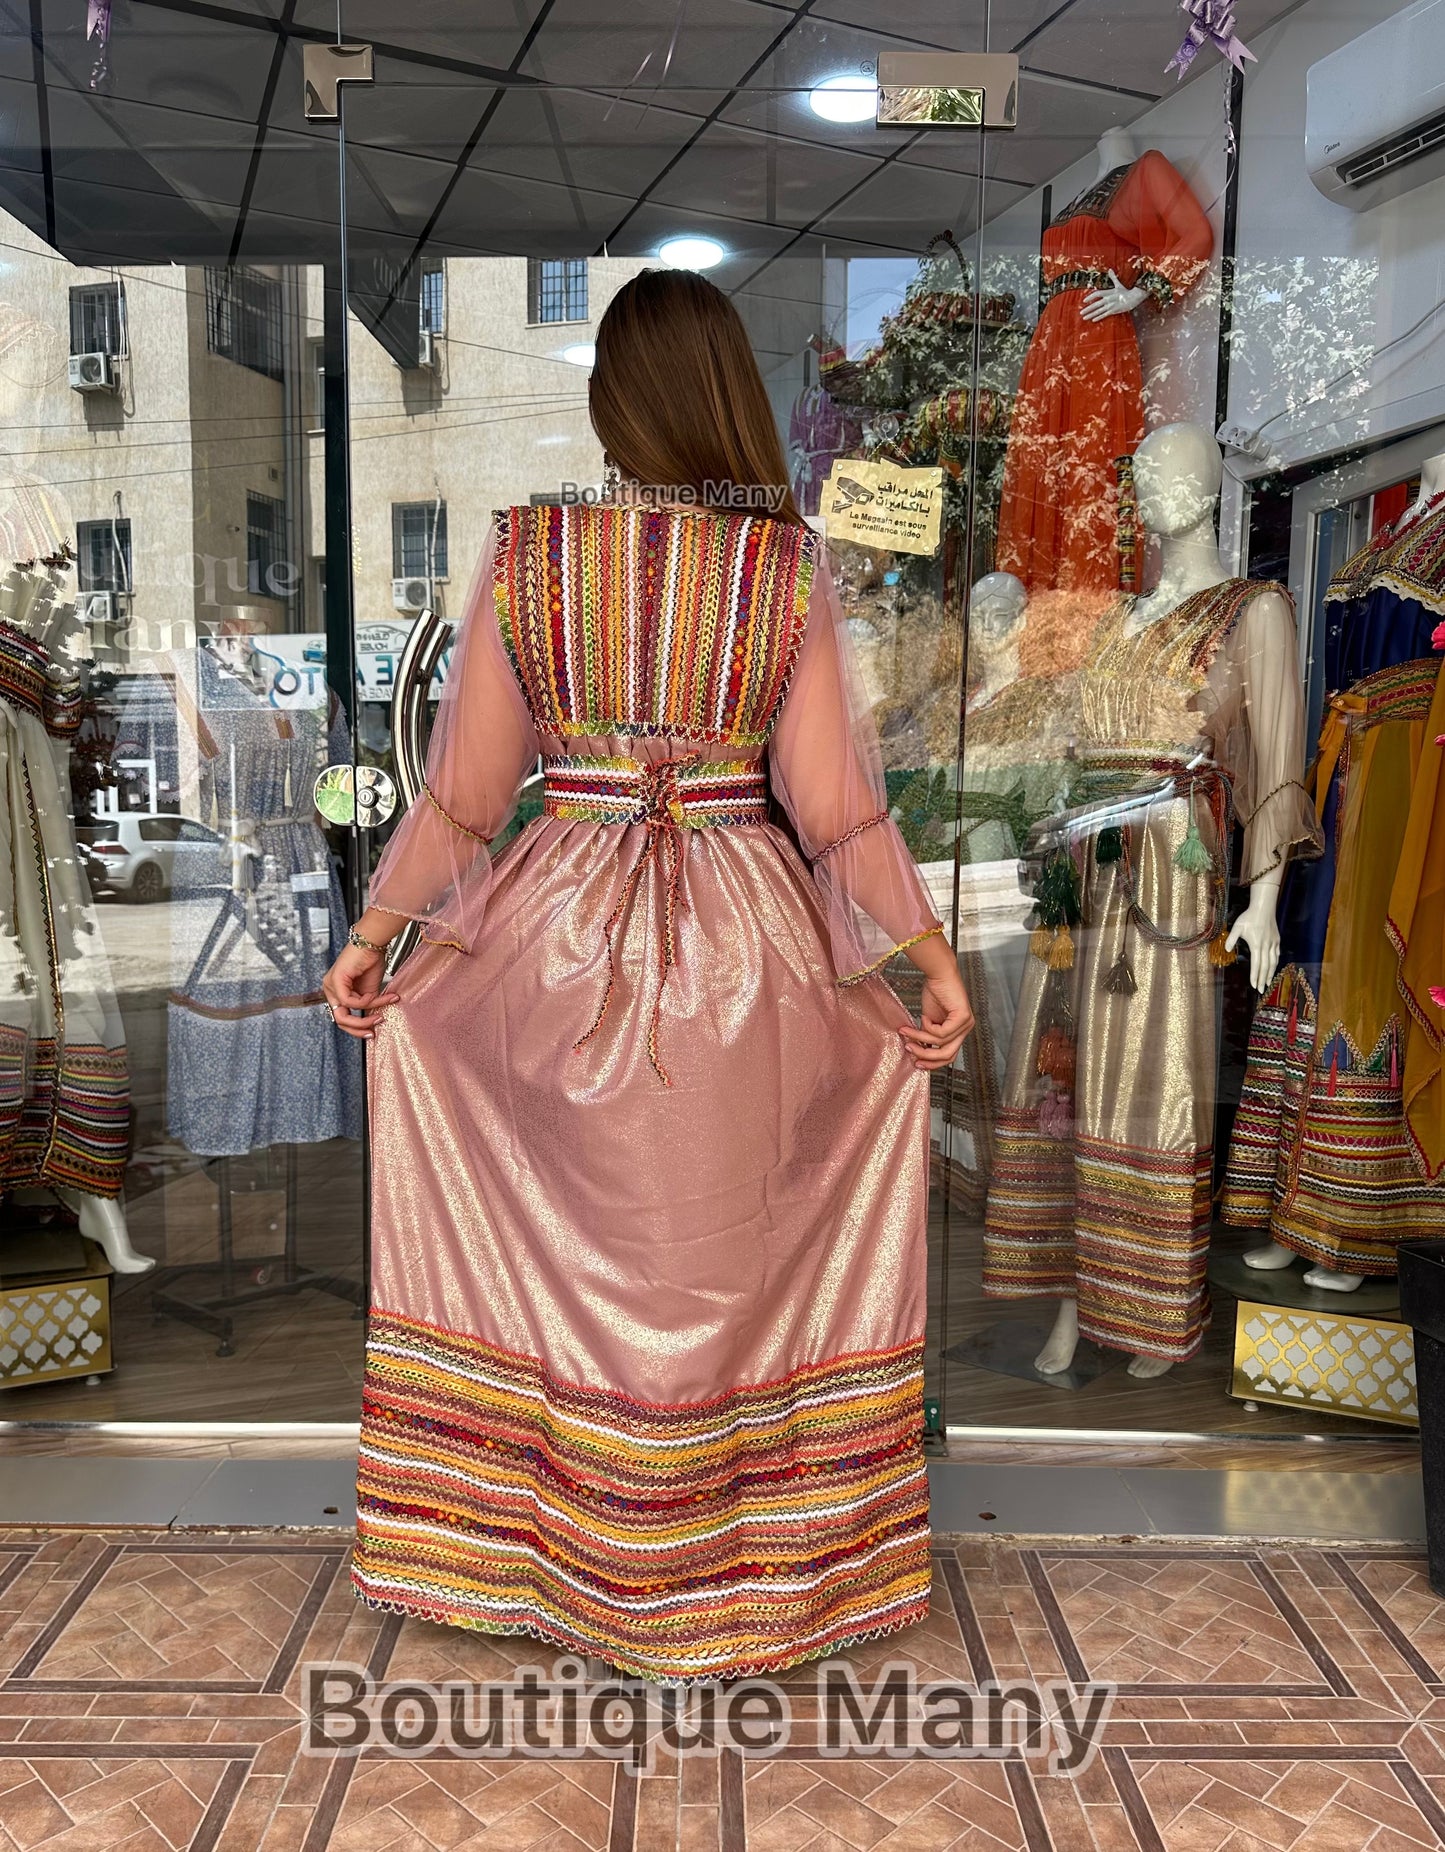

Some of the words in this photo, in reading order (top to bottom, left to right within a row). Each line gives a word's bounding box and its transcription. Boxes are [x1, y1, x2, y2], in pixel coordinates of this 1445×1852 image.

[878, 481, 909, 496] مراقب
[909, 487, 934, 500] المحل
[849, 511, 859, 519] Le
[894, 519, 907, 527] est
[908, 521, 928, 530] sous
